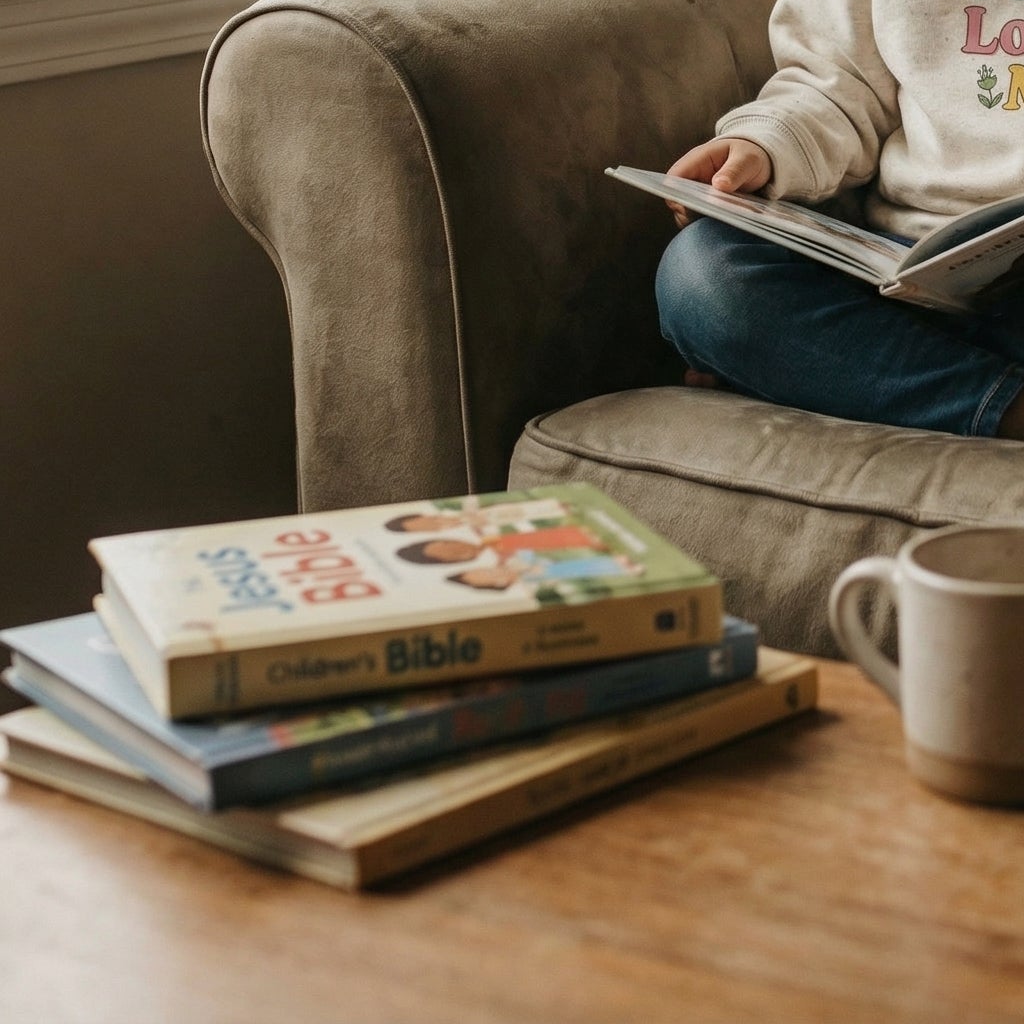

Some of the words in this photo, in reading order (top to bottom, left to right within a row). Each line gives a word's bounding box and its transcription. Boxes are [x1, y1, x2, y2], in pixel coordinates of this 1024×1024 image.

[198, 546, 293, 613] Jesus
[262, 529, 383, 605] Bible
[387, 629, 482, 674] Bible
